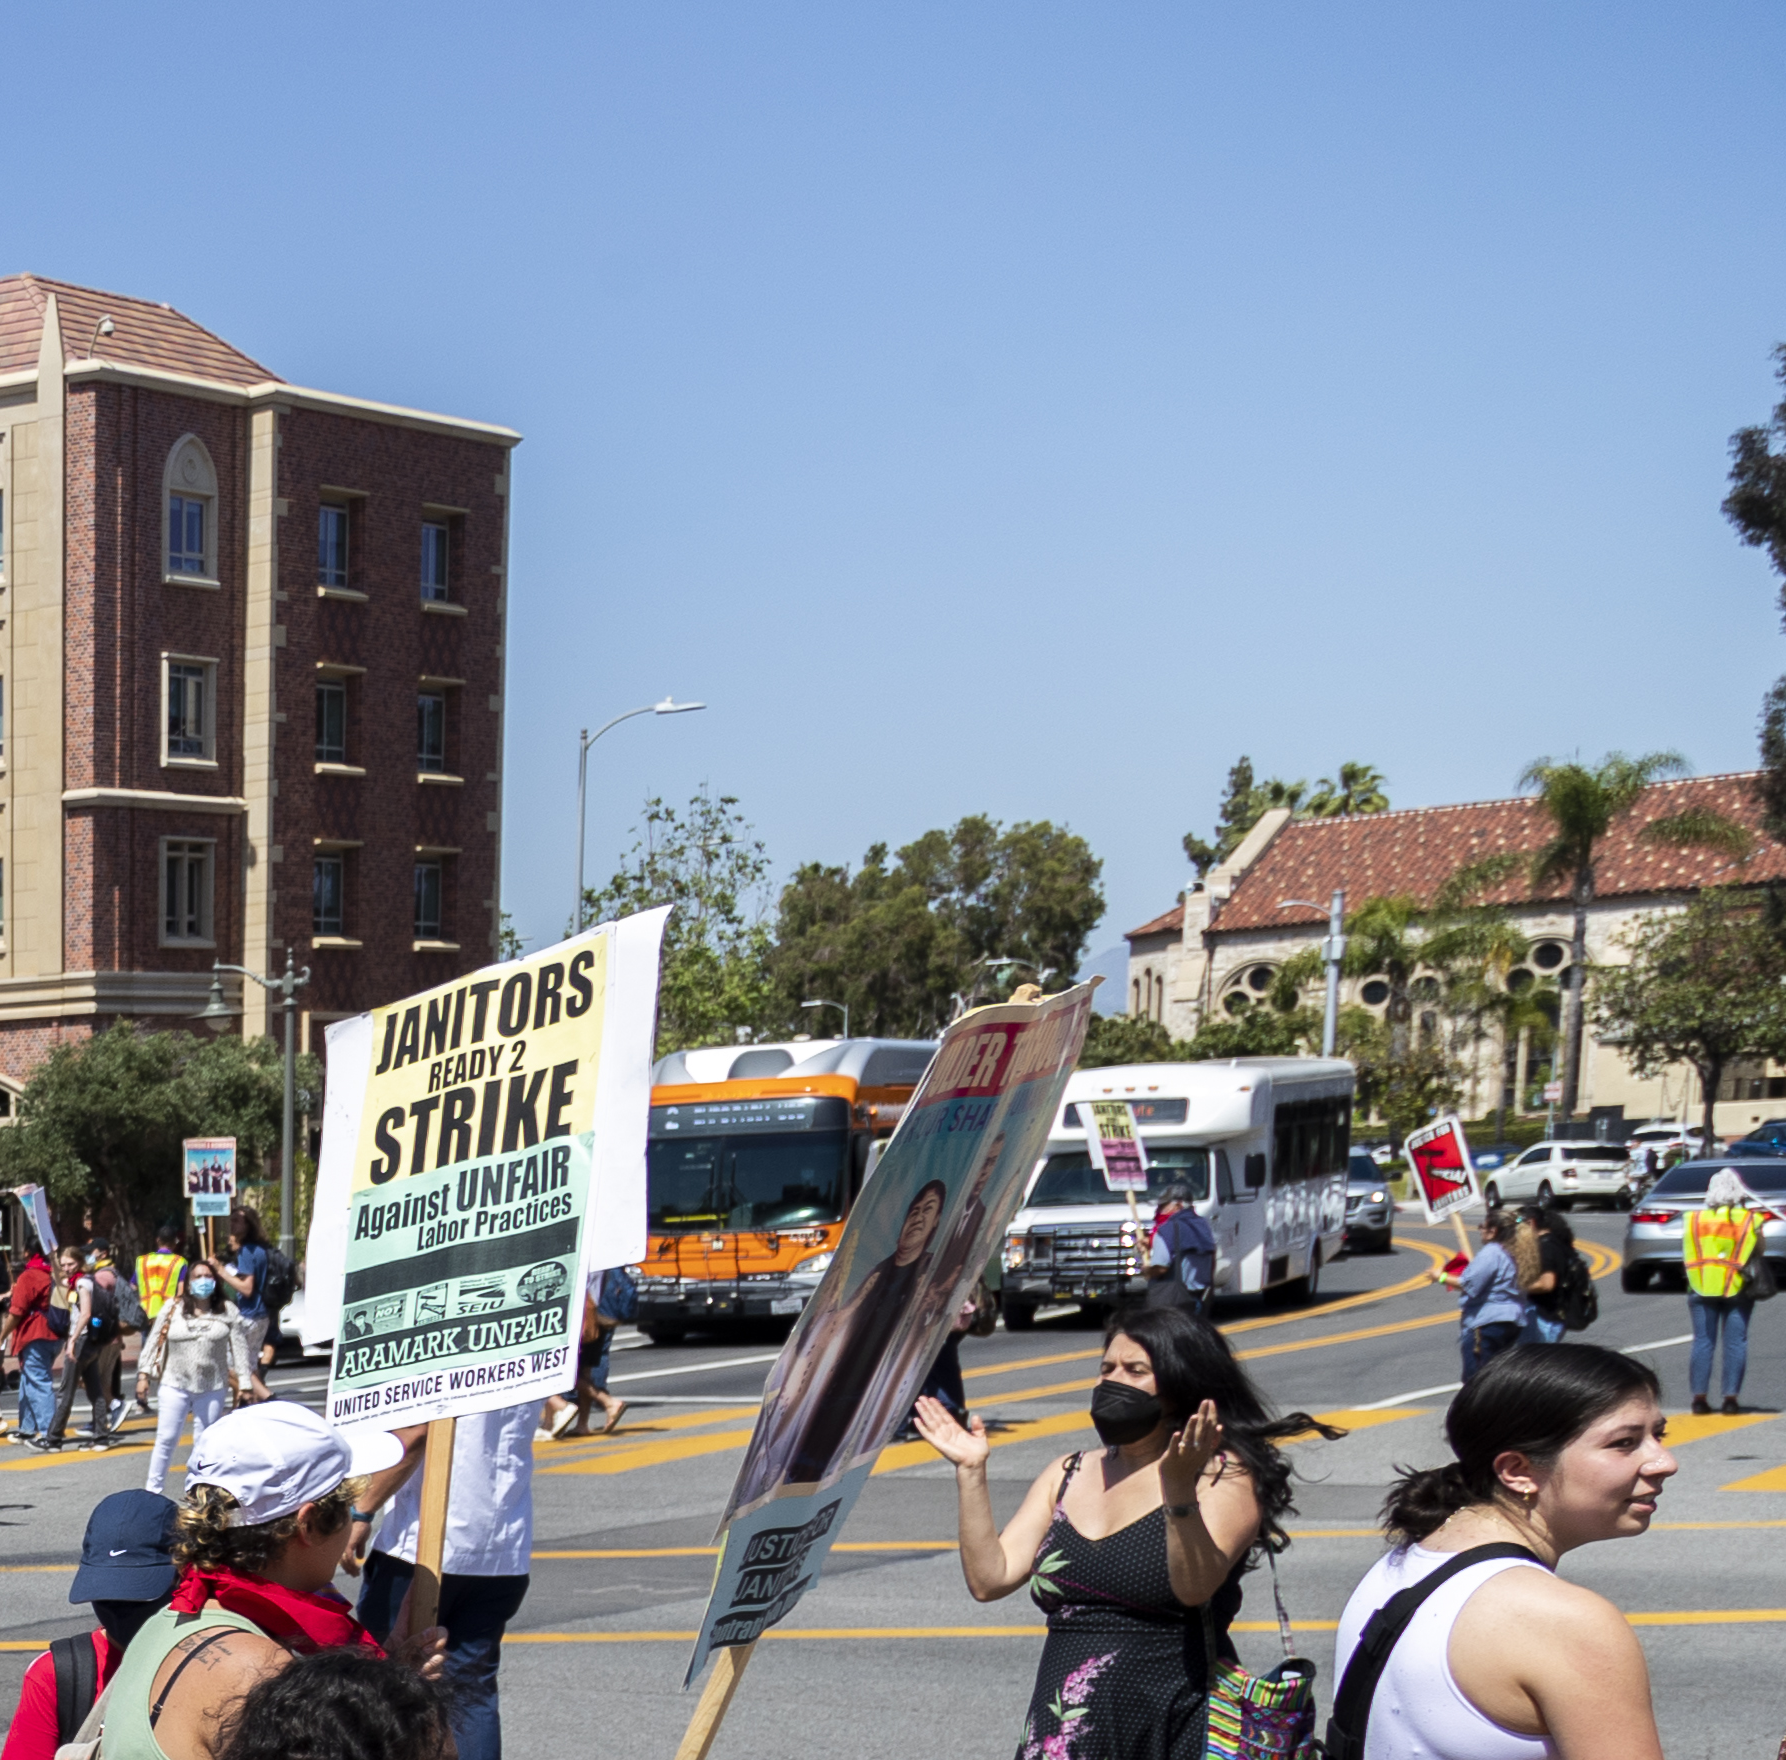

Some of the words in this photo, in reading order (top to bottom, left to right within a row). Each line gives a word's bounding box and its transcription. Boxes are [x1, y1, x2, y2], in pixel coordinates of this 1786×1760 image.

[376, 950, 595, 1077] JANITORS
[428, 1044, 506, 1094] READY
[508, 1040, 527, 1073] 2
[370, 1058, 579, 1185] STRIKE
[948, 1103, 999, 1132] SHA
[354, 1184, 451, 1241] Against
[456, 1145, 570, 1212] UNFAIR
[416, 1217, 470, 1252] Labor
[474, 1192, 573, 1238] Practices
[375, 1305, 402, 1318] NOT
[456, 1299, 505, 1315] SEIU
[339, 1327, 462, 1378] ARAMARK
[468, 1306, 564, 1351] UNFAIR
[334, 1390, 380, 1418] UNITED
[385, 1375, 443, 1405] SERVICE
[449, 1358, 526, 1390] WORKERS
[531, 1346, 570, 1373] WEST
